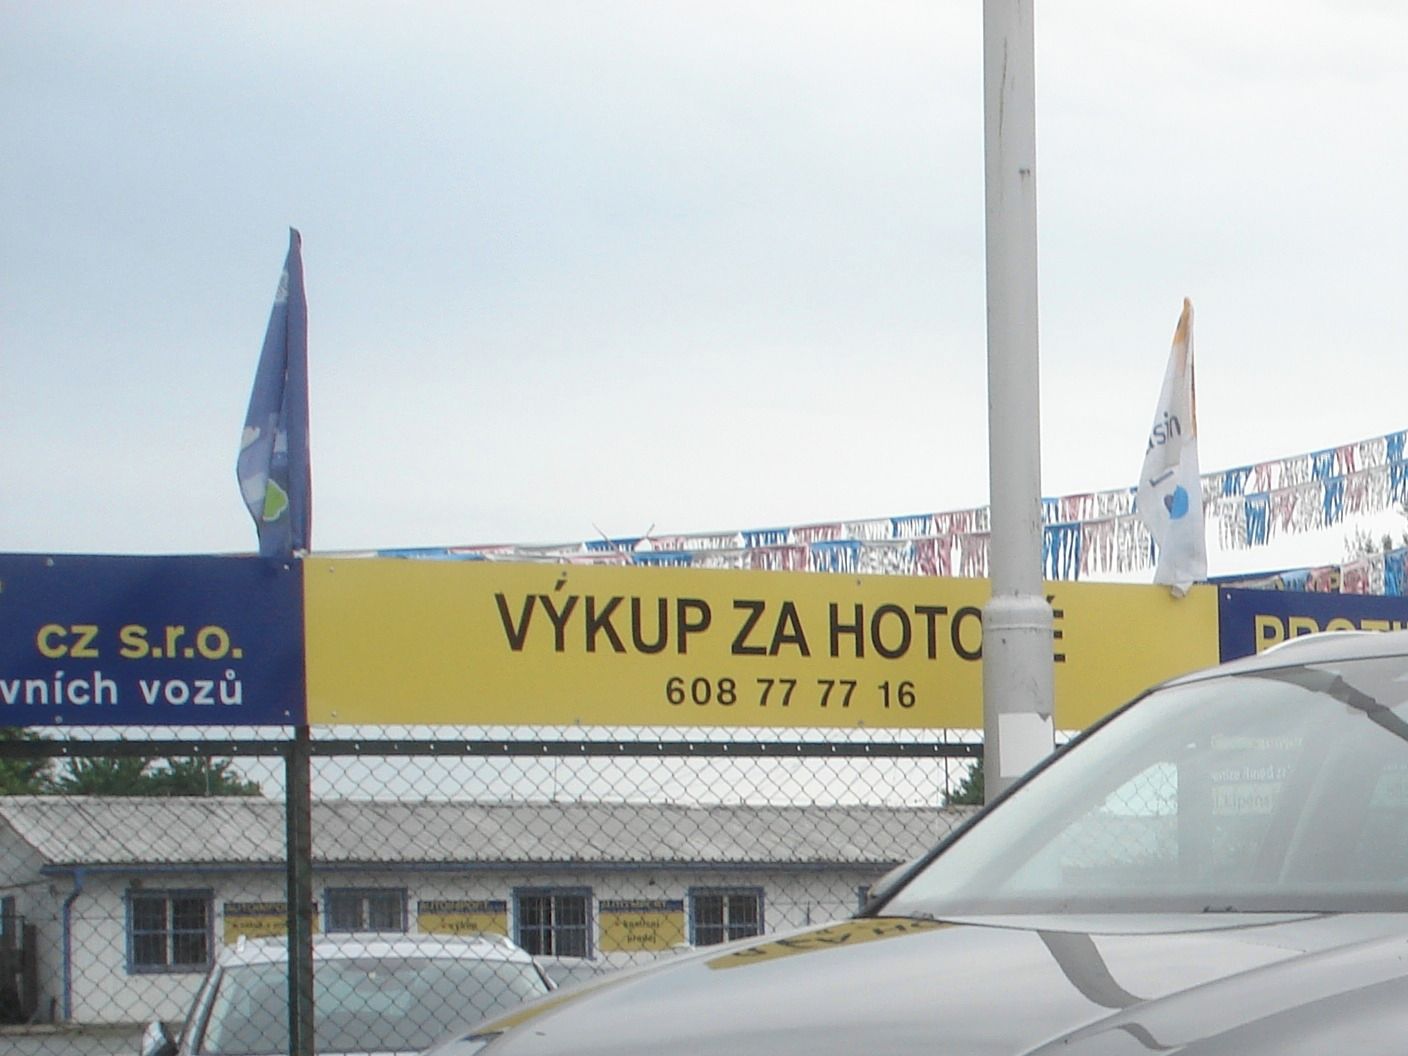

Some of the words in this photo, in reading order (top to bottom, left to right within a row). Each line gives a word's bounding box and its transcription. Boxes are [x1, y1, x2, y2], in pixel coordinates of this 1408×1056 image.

[495, 580, 711, 655] VÝKUP
[732, 600, 810, 657] ZA
[829, 594, 1066, 664] HOTO
[36, 624, 99, 658] cz
[119, 624, 243, 659] s.r.o.
[139, 669, 243, 705] vozů
[666, 676, 737, 707] 608
[756, 677, 797, 707] 77
[817, 679, 858, 708] 77
[877, 680, 917, 709] 16
